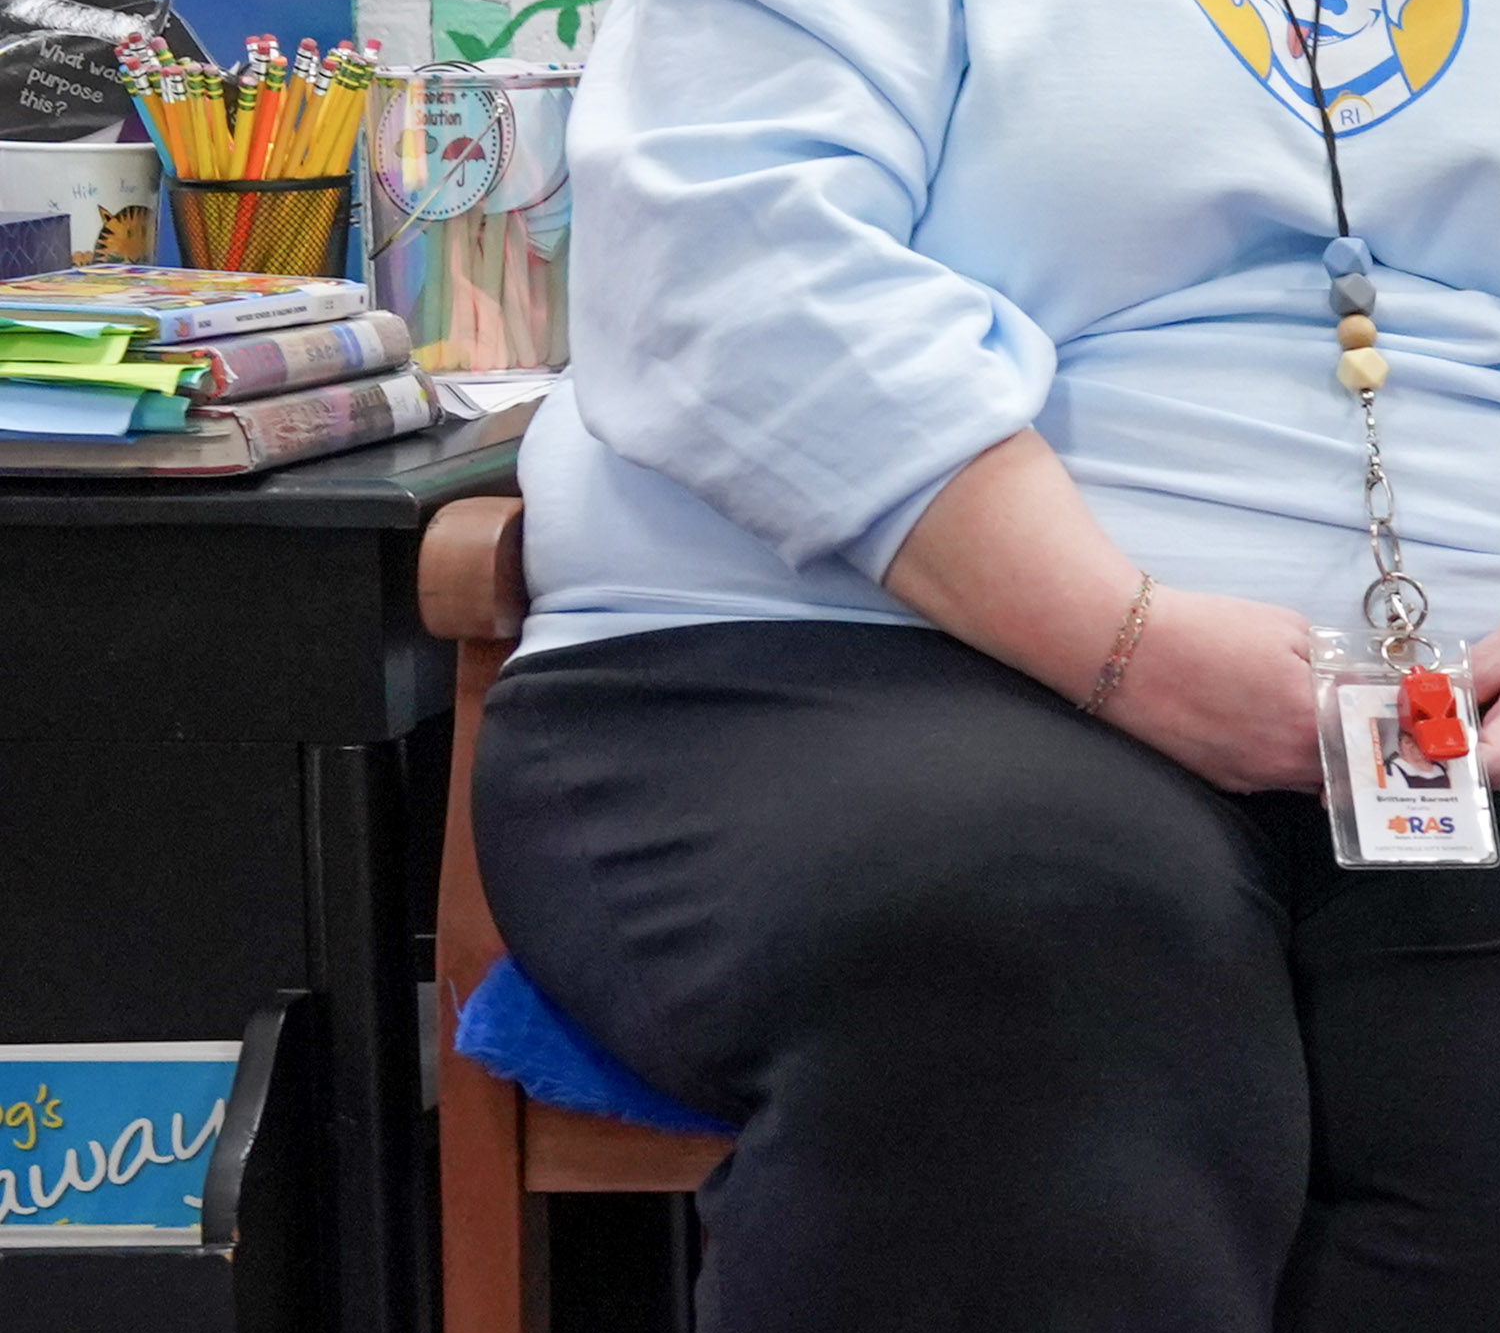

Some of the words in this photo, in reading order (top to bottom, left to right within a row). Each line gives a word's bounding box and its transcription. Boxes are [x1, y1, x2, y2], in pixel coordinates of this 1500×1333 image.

[40, 39, 85, 70] What
[27, 68, 104, 103] purpose
[20, 88, 68, 116] this?
[415, 110, 462, 126] Solution
[1340, 108, 1361, 126] RI
[1408, 816, 1455, 834] RAS
[0, 1084, 63, 1151] g's
